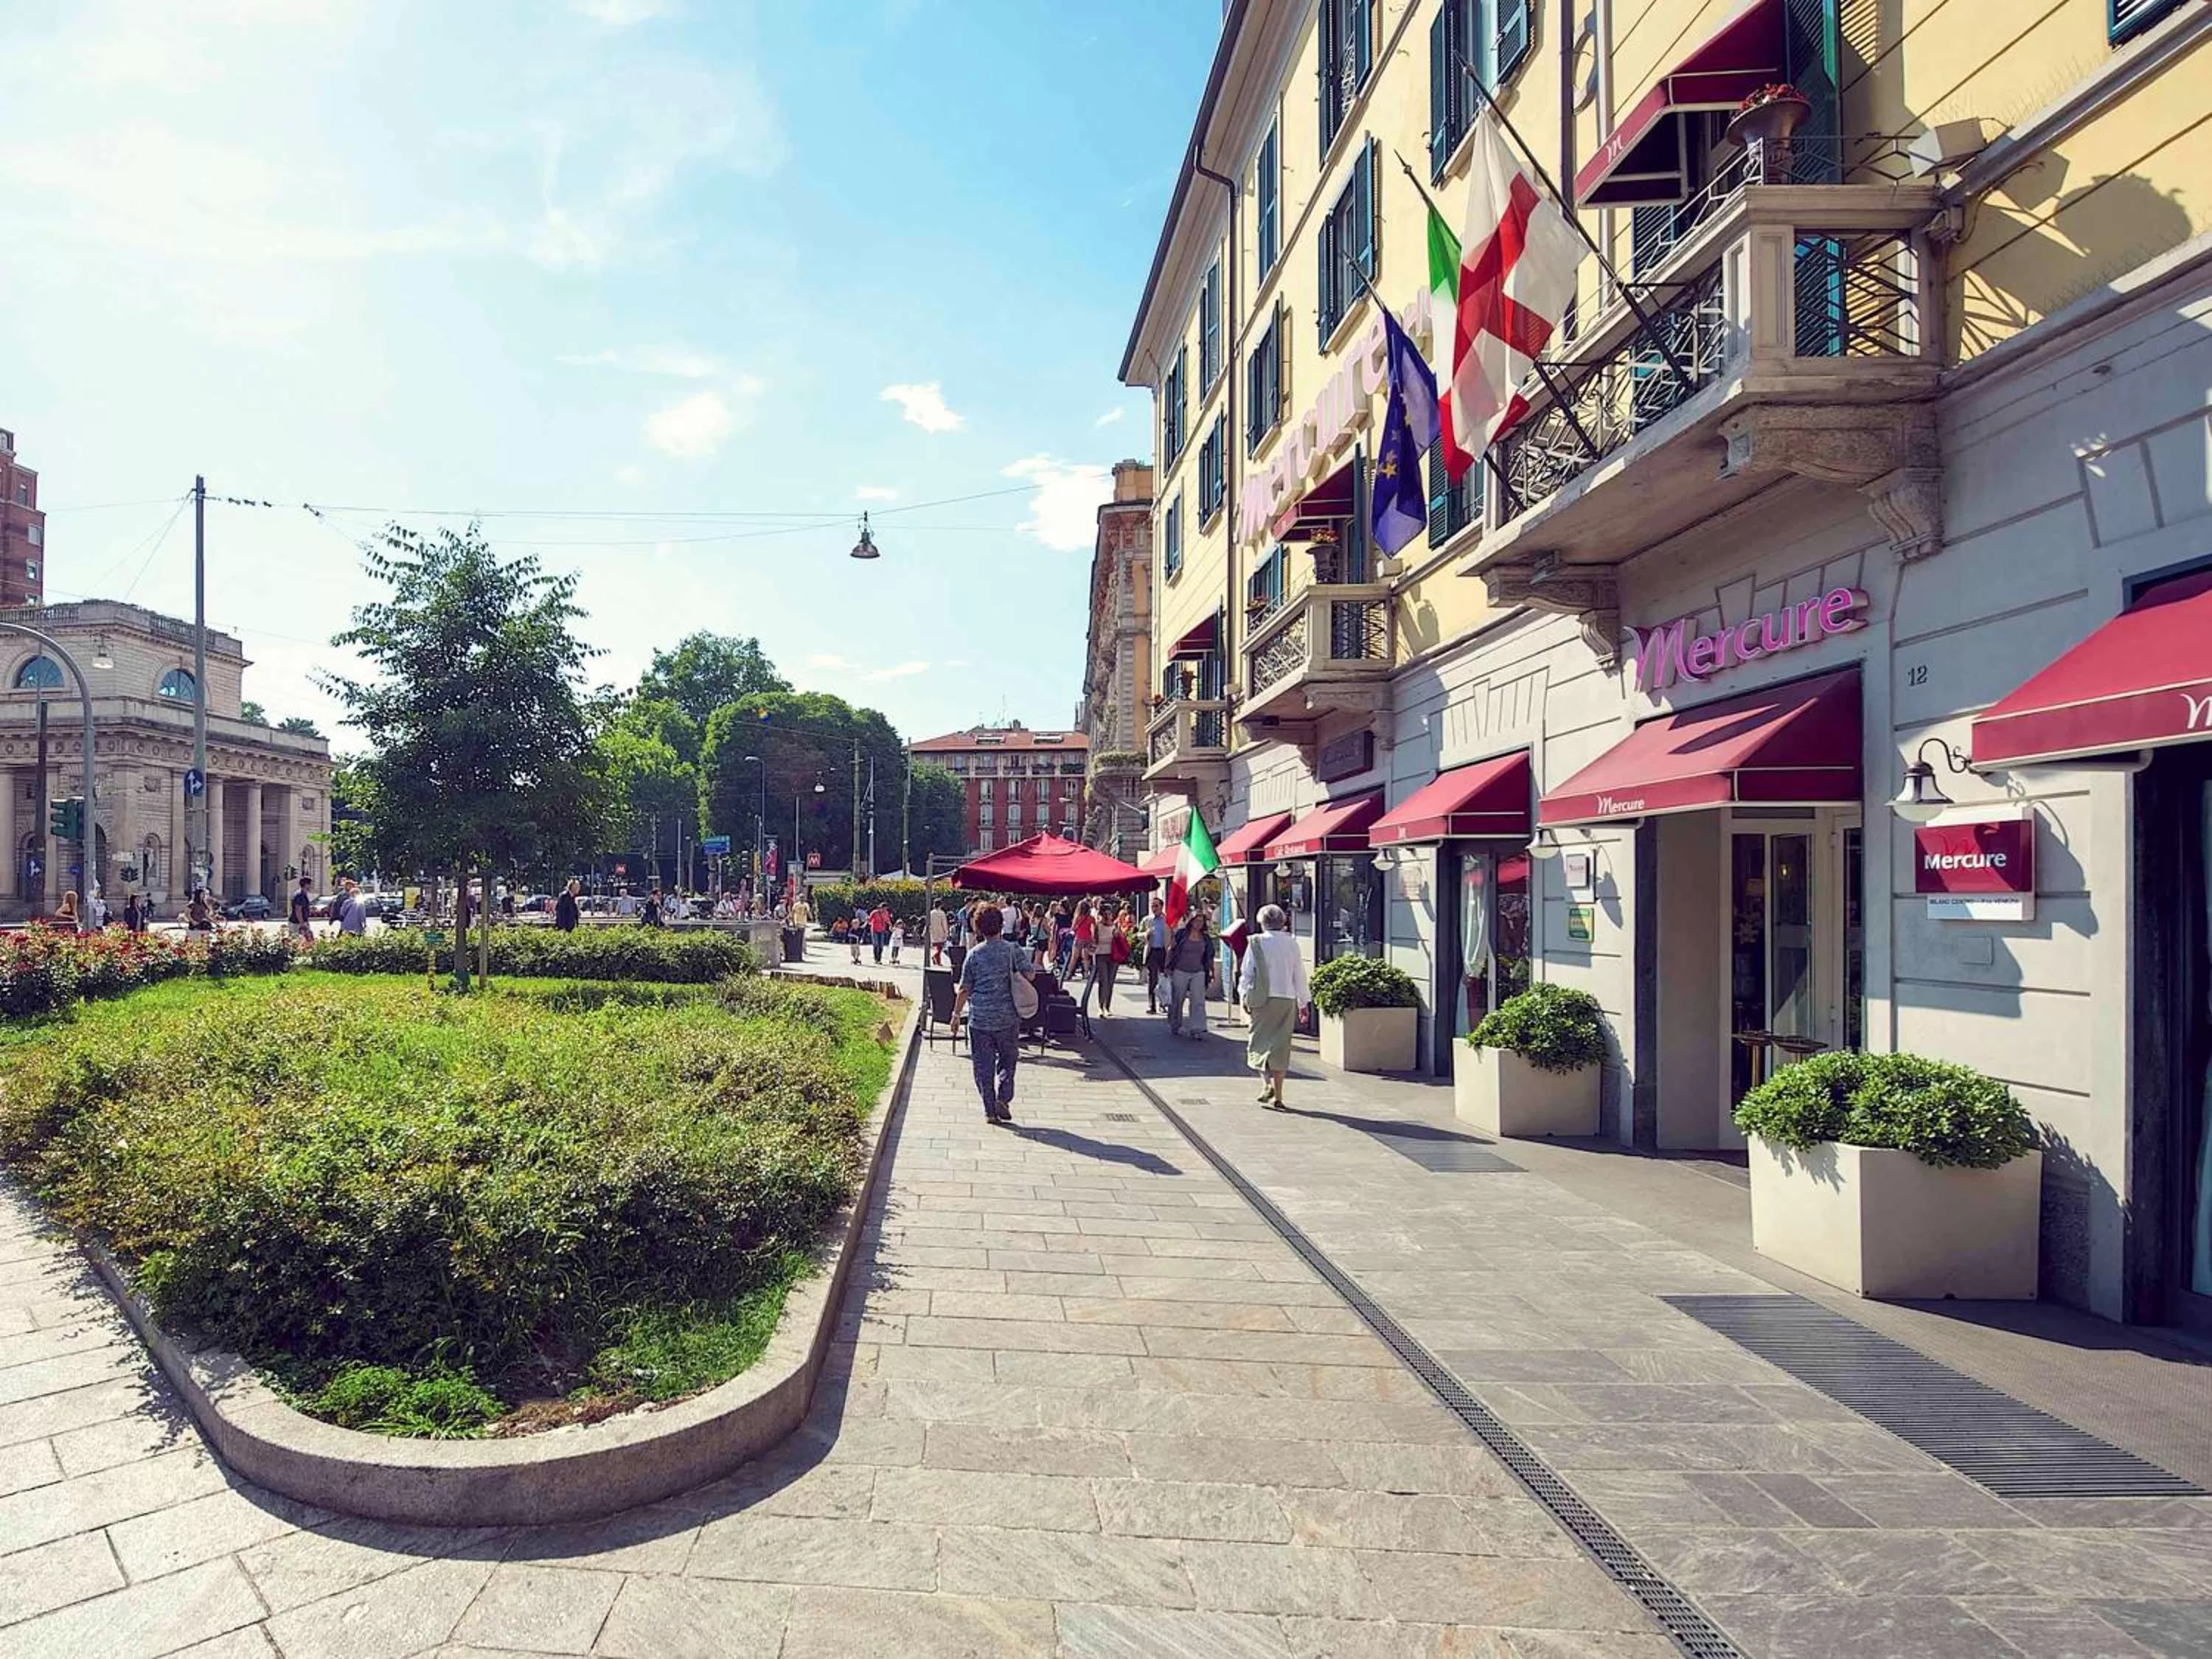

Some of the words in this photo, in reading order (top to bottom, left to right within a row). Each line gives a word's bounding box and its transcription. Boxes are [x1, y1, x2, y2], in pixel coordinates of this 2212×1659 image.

[1236, 310, 1389, 547] Mercure
[1623, 588, 1854, 692] Mercure
[1908, 665, 1928, 686] 12
[1596, 795, 1646, 814] Mercure
[1924, 853, 2006, 869] Mercure
